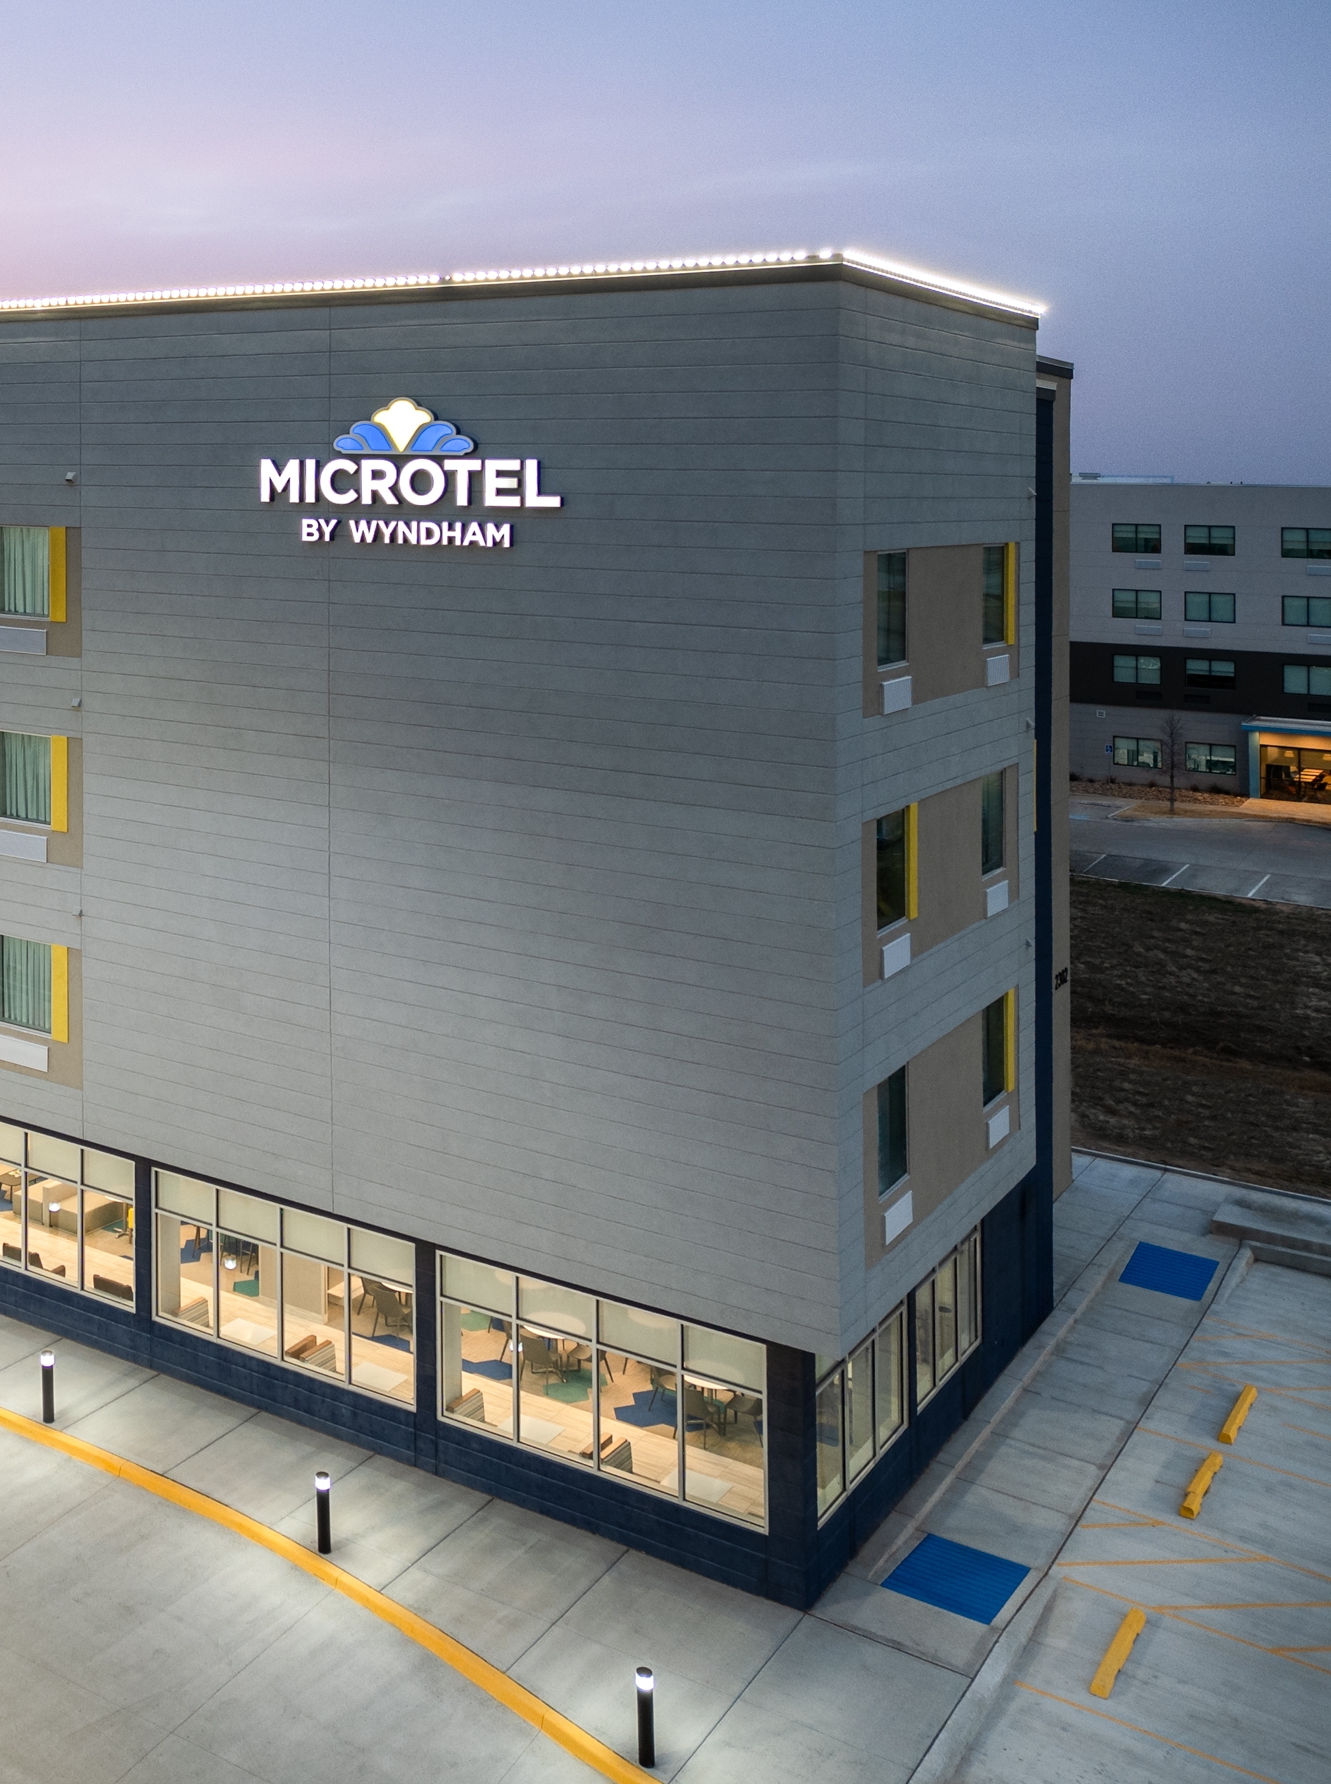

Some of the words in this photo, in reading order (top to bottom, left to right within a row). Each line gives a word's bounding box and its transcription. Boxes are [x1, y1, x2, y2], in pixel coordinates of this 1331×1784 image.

[260, 458, 561, 507] MICROTEL
[301, 518, 337, 542] BY
[349, 519, 511, 548] WYNDHAM
